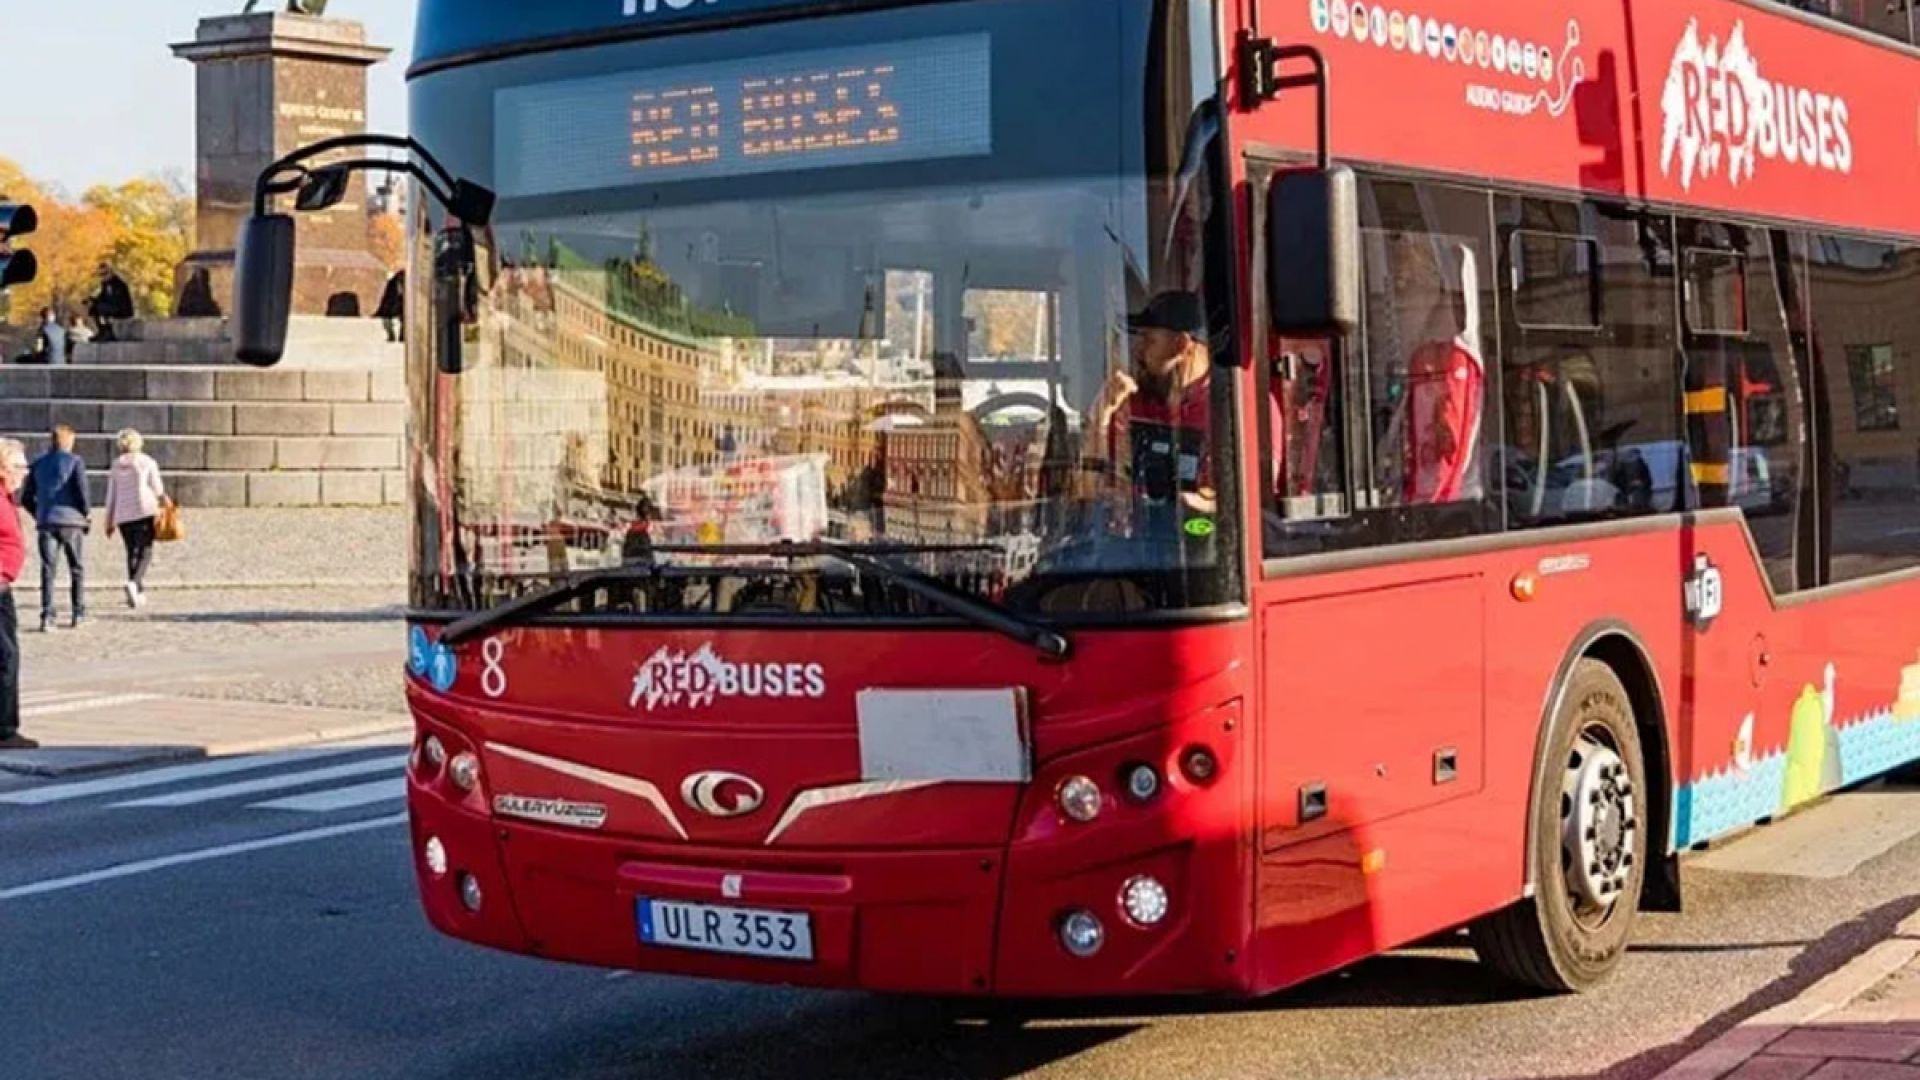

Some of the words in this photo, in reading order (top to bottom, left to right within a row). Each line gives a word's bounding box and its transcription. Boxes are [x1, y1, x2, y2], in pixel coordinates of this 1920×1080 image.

[632, 86, 719, 167] RED
[743, 66, 898, 155] BUSES
[1682, 60, 1750, 147] RED
[1758, 78, 1853, 175] BUSES
[481, 636, 506, 698] 8
[650, 661, 711, 693] RED
[719, 662, 825, 697] BUSES
[662, 906, 723, 945] ULR
[733, 912, 797, 951] 353
